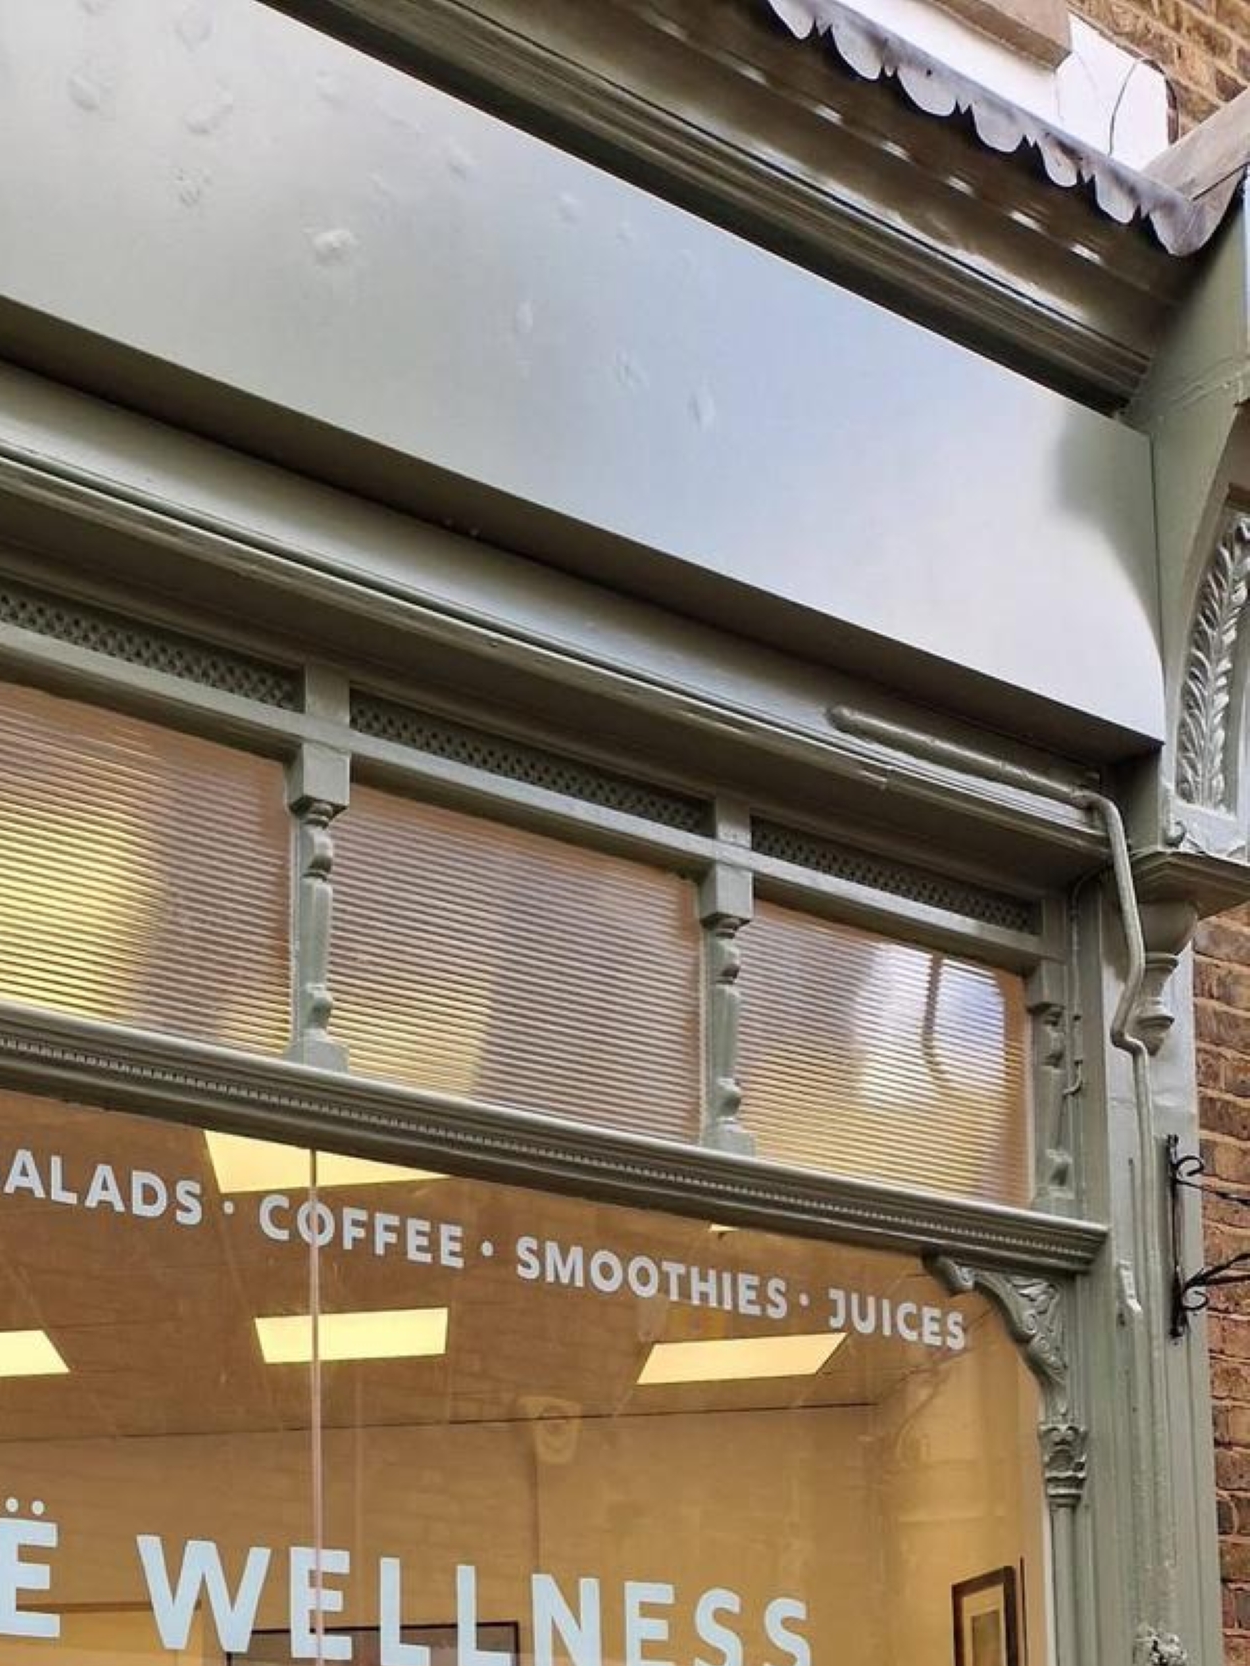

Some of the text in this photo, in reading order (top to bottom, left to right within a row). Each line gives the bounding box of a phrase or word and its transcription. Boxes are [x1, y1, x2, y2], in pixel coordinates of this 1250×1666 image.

[258, 1194, 465, 1269] COFFEE
[516, 1236, 787, 1320] SMOOTHIES
[828, 1288, 966, 1351] JUICES
